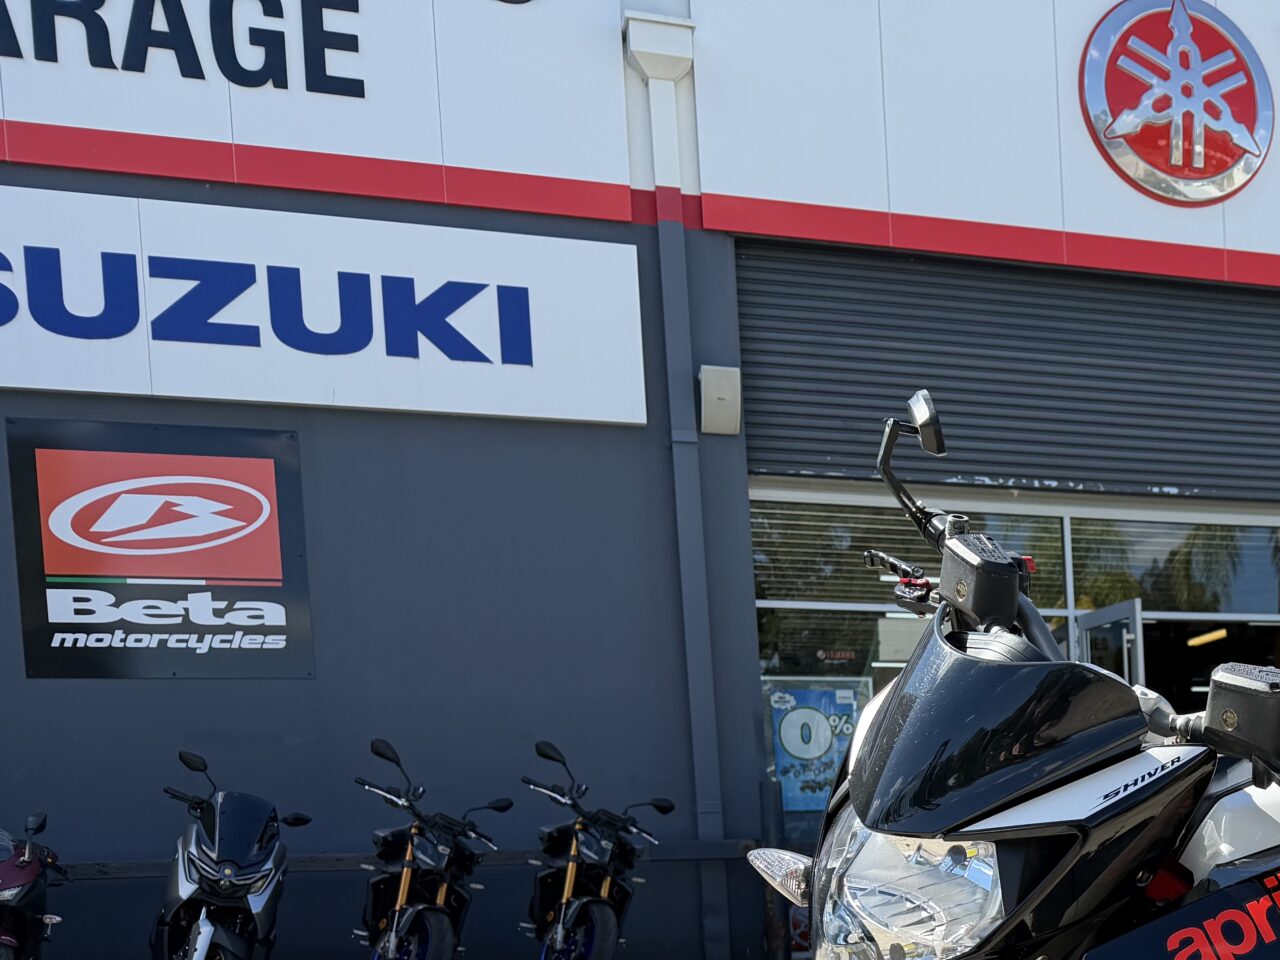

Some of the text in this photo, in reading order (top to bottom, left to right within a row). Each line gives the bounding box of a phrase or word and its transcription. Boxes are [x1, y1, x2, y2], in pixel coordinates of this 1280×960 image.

[0, 0, 365, 98] RAGE
[0, 245, 533, 367] UZUKI
[46, 588, 287, 626] Beta
[50, 630, 287, 653] motorcycles
[1098, 756, 1182, 802] SHIVER
